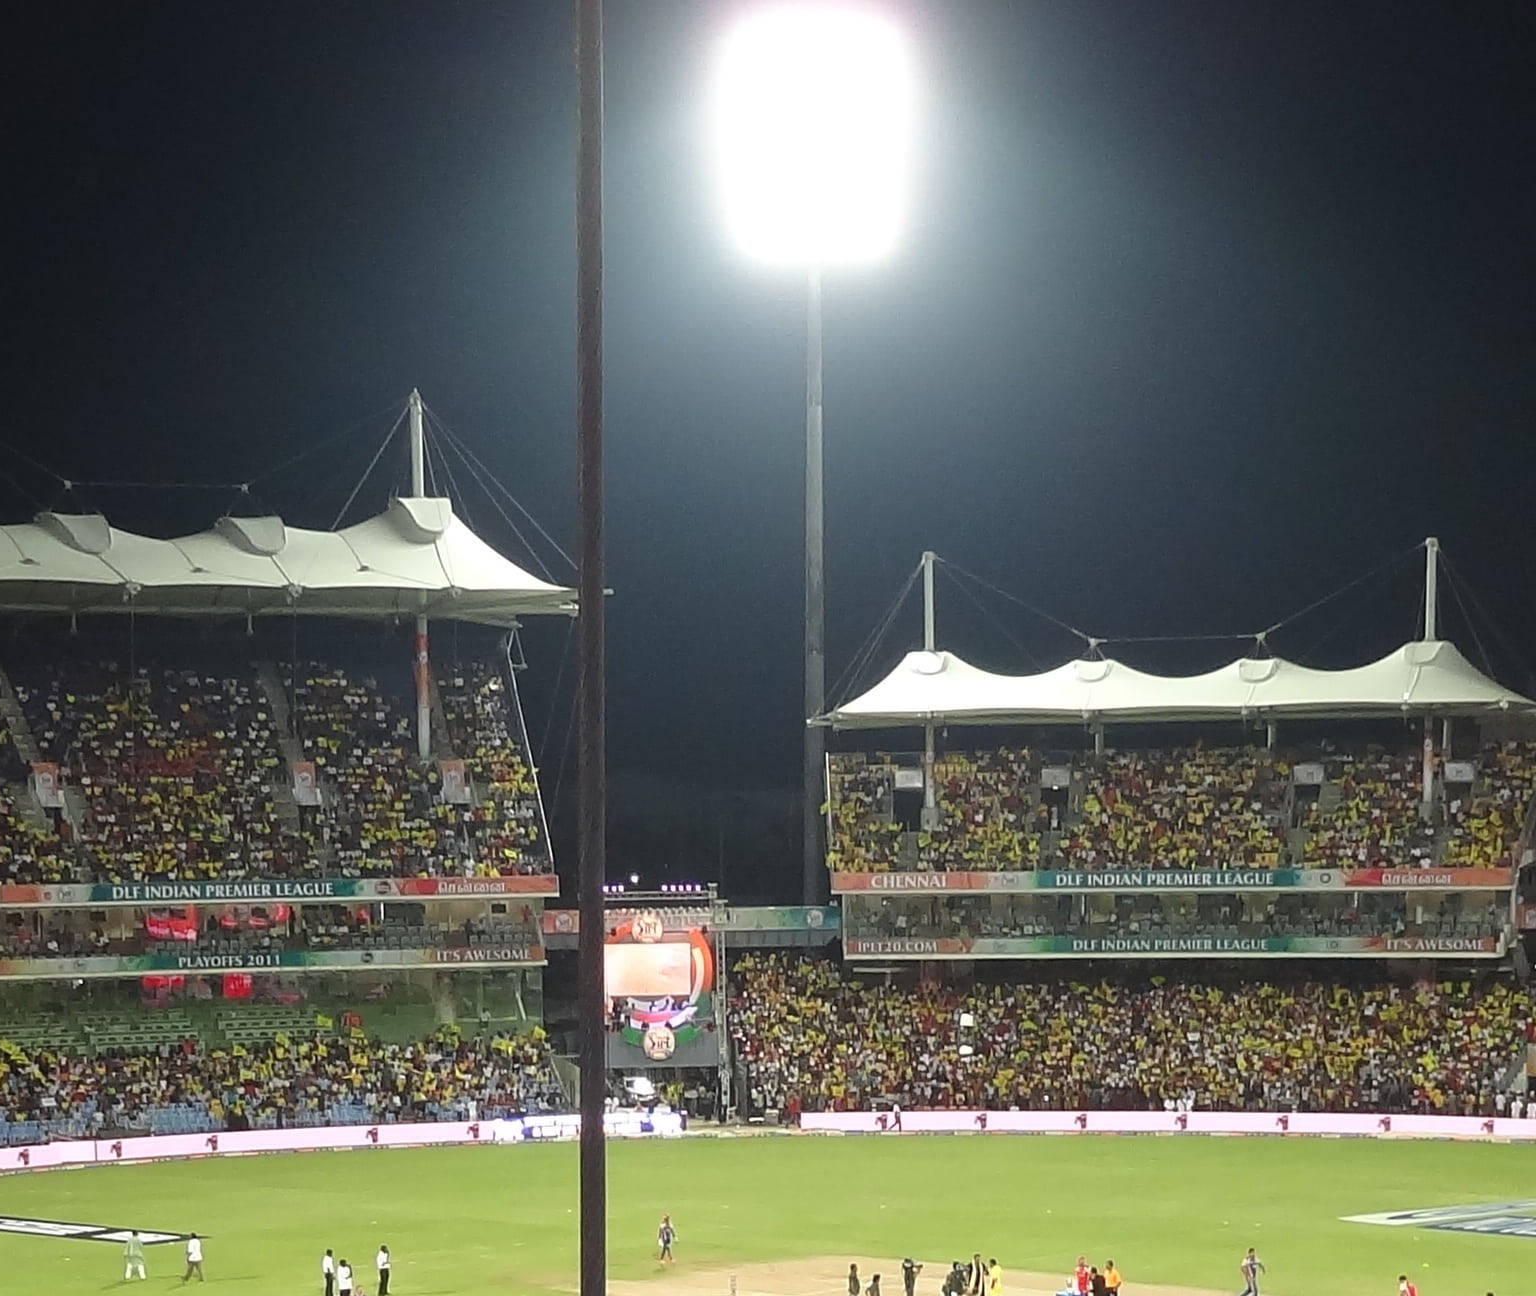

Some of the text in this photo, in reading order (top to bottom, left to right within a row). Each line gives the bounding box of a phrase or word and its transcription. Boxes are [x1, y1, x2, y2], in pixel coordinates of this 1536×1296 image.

[871, 874, 946, 889] CHENNAI
[1055, 872, 1274, 887] DLF INDIAN PREMIER LEAGUE
[112, 882, 334, 899] DLF INDIAN PREMIER LEAGUE
[858, 941, 937, 953] IPLT20.COM
[1073, 938, 1268, 951] DLF INDIAN PREMIER LEAGUE
[1387, 938, 1485, 950] IT'S AWESOME
[178, 953, 280, 968] PLAYOFFS 2011
[437, 949, 531, 962] IT'S AWESOME
